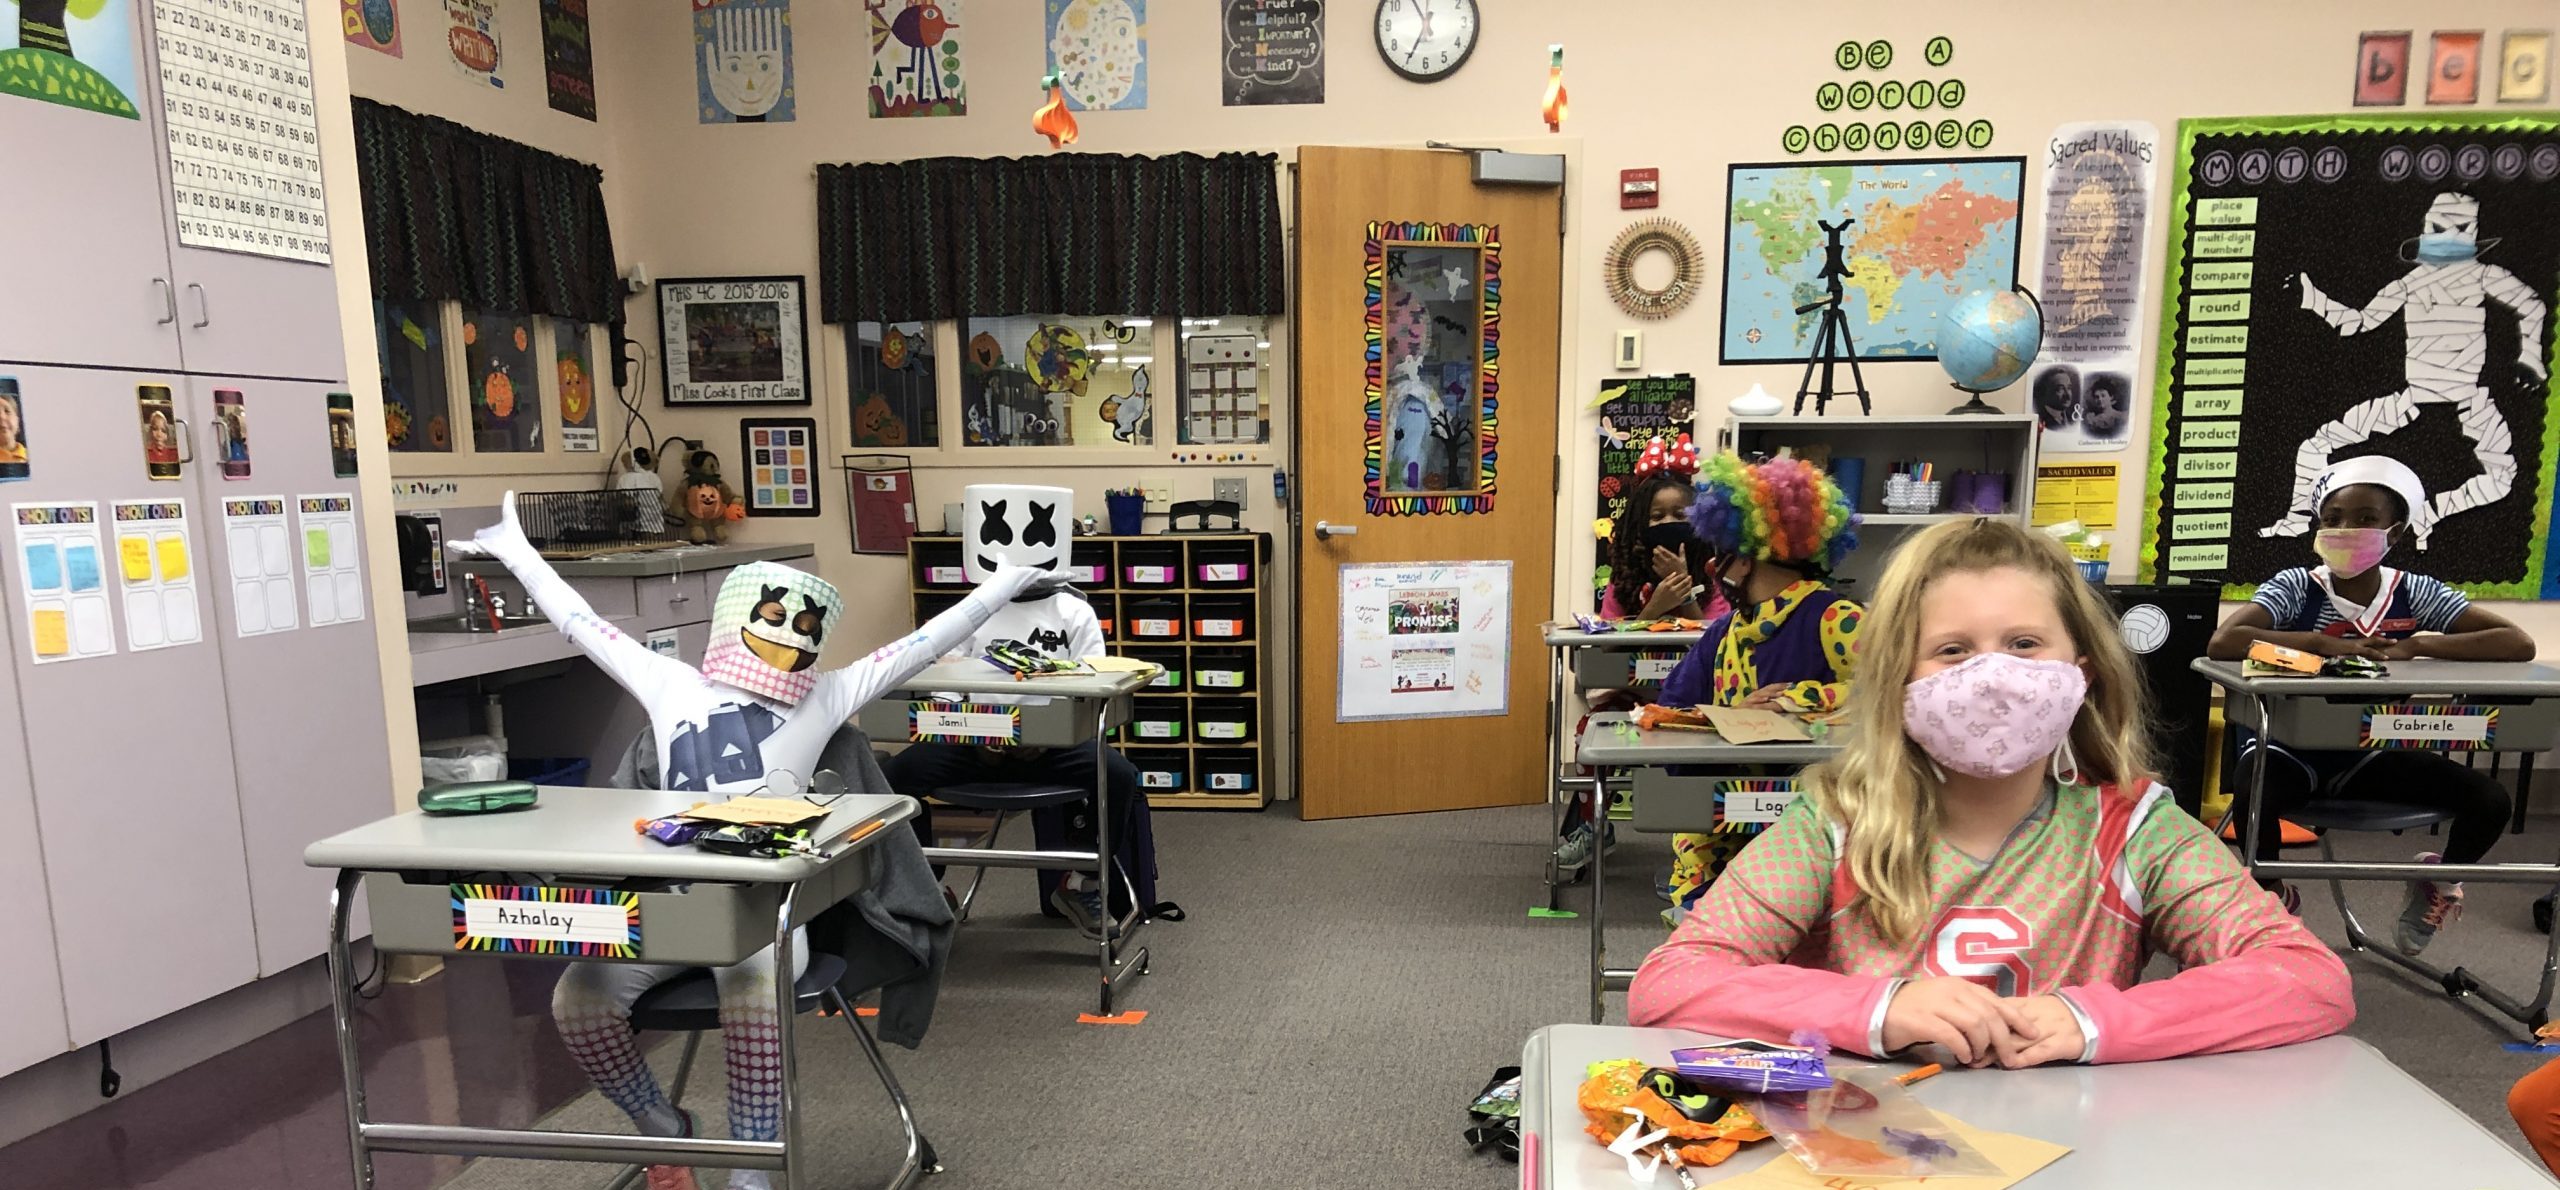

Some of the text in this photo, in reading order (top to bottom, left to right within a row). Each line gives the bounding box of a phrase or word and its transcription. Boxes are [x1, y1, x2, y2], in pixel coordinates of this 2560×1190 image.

[156, 6, 306, 60] 21 22 23 24 25 26 27 28 29 30
[1454, 36, 1461, 48] 4
[1422, 57, 1429, 70] 6
[1441, 51, 1448, 63] 5
[163, 69, 311, 116] 41 42 43 44 45 46 47 48 49 50
[170, 129, 317, 172] 61 62 63 64 65 66 67 68 69 70
[2048, 129, 2153, 168] Sacred Values
[2206, 149, 2560, 180] MATH WORDS
[1858, 179, 1909, 191] The World
[177, 190, 324, 226] 81 82 83 84 85 86 87 88 89 90
[2211, 201, 2243, 213] place
[2210, 214, 2241, 223] value
[2197, 232, 2252, 244] multi-digit
[2203, 245, 2244, 254] number
[2194, 272, 2250, 283] compare
[697, 285, 716, 300] 4C
[724, 283, 789, 300] 2015-2016
[1660, 279, 1688, 304] cook
[2199, 300, 2241, 313] round
[2190, 333, 2245, 345] estimate
[2186, 367, 2244, 376] multiplication
[673, 384, 700, 400] Miss
[741, 384, 767, 400] First
[772, 384, 801, 398] Class
[1629, 390, 1677, 403] alligator
[2194, 400, 2231, 411] array
[1630, 426, 1680, 438] bye bye
[2183, 428, 2238, 442] product
[2047, 467, 2114, 476] SACRED VALUES
[2183, 459, 2231, 471] divisor
[2176, 489, 2232, 501] dividend
[2176, 521, 2229, 534] quotient
[2172, 552, 2225, 563] remainder
[1394, 615, 1453, 628] PROMISE
[938, 715, 968, 728] Jamil
[2393, 719, 2454, 732] Gabriele
[498, 907, 574, 935] Azhalay
